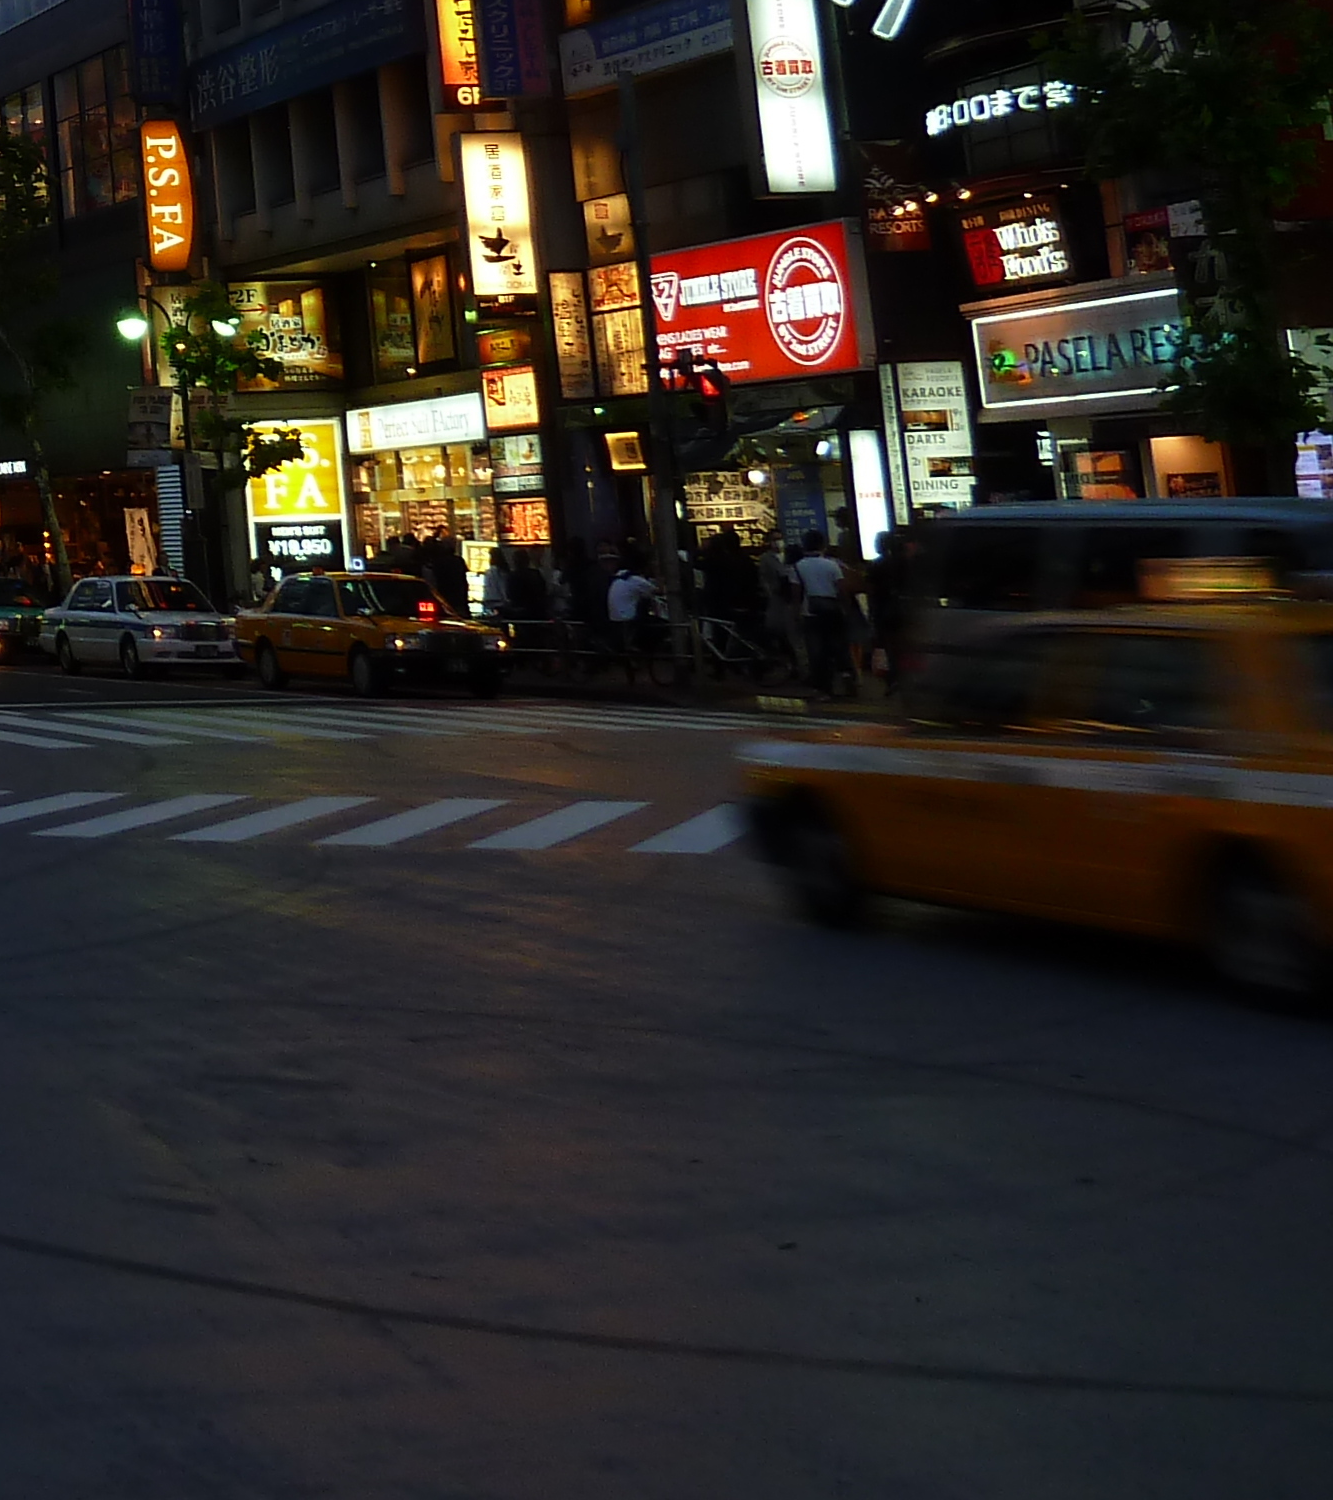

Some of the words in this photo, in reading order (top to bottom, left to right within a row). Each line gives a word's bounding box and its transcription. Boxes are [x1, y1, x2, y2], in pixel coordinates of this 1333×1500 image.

[760, 59, 814, 77] 古着買取
[196, 44, 279, 114] 渋谷整形
[235, 288, 258, 304] 2F
[1024, 332, 1130, 379] PASELA
[902, 385, 963, 399] KARAOKE
[906, 433, 947, 445] DARTS
[912, 479, 959, 491] DINING
